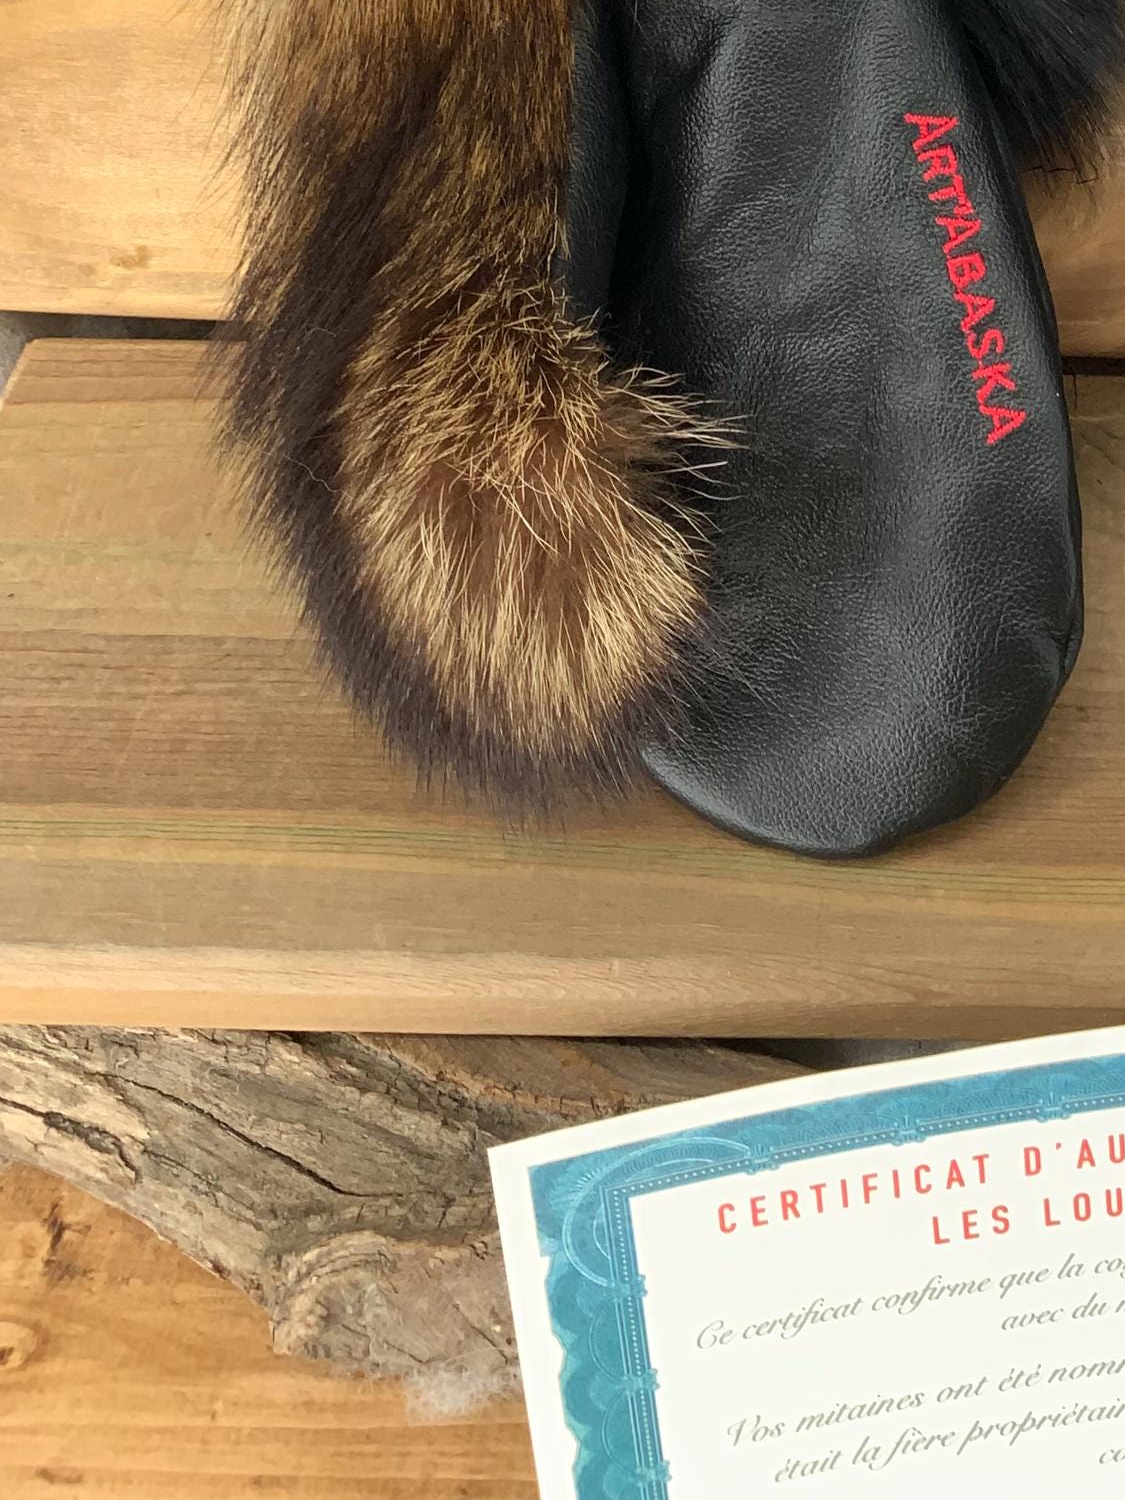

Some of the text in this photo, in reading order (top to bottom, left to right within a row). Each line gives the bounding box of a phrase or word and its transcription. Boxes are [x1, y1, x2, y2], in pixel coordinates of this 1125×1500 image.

[717, 1152, 992, 1234] CERTIFICAT
[932, 1205, 1010, 1244] LES
[696, 1320, 734, 1349] Ce
[742, 1297, 862, 1340] certificat
[871, 1274, 991, 1315] confirme
[999, 1267, 1050, 1300] que
[1057, 1252, 1085, 1280] la
[1001, 1306, 1065, 1331] avec
[1072, 1292, 1108, 1320] du
[726, 1414, 786, 1447] Vos
[795, 1393, 925, 1433] mitaines
[936, 1377, 987, 1404] ont
[998, 1364, 1041, 1392] été
[774, 1450, 842, 1483] était
[852, 1435, 882, 1466] la
[868, 1426, 957, 1471] fière
